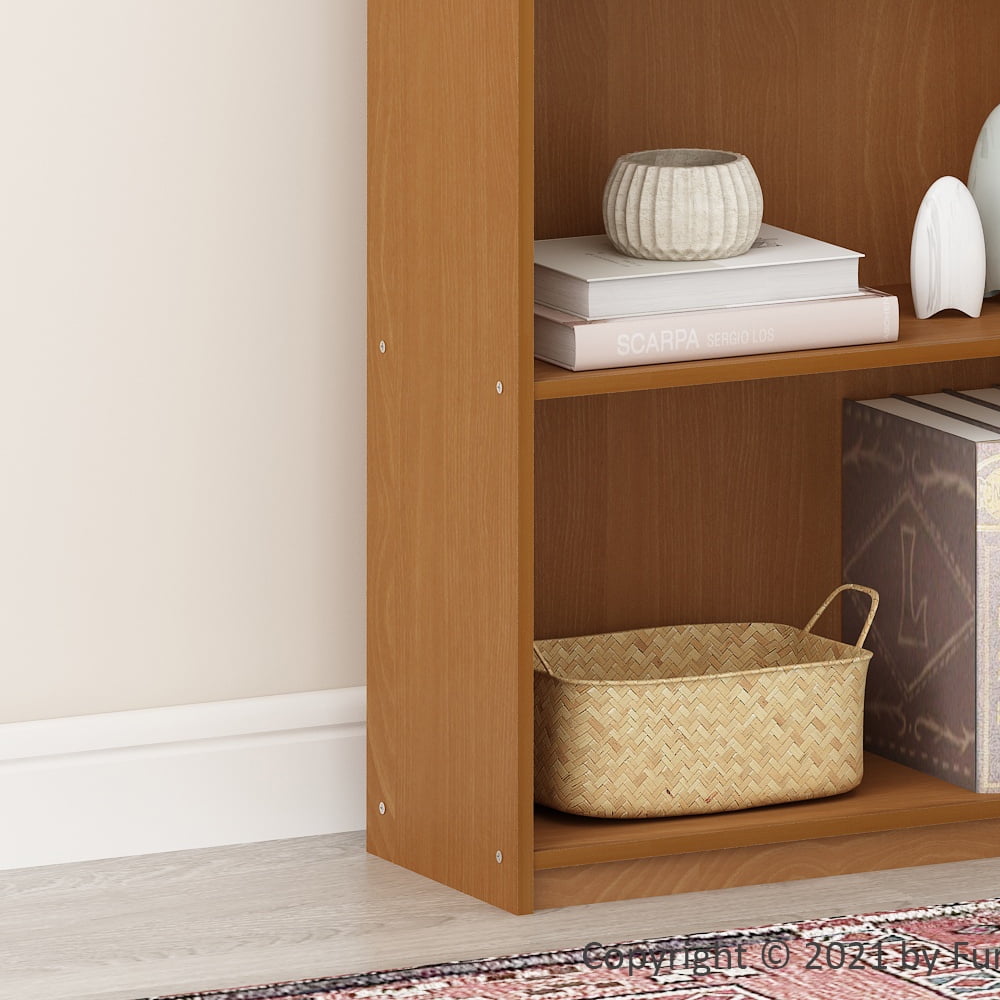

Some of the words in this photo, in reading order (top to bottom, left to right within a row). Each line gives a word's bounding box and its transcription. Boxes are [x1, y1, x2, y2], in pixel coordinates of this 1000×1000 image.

[616, 327, 700, 356] SCARPA
[706, 329, 749, 348] SERGIO
[752, 327, 775, 345] LOS
